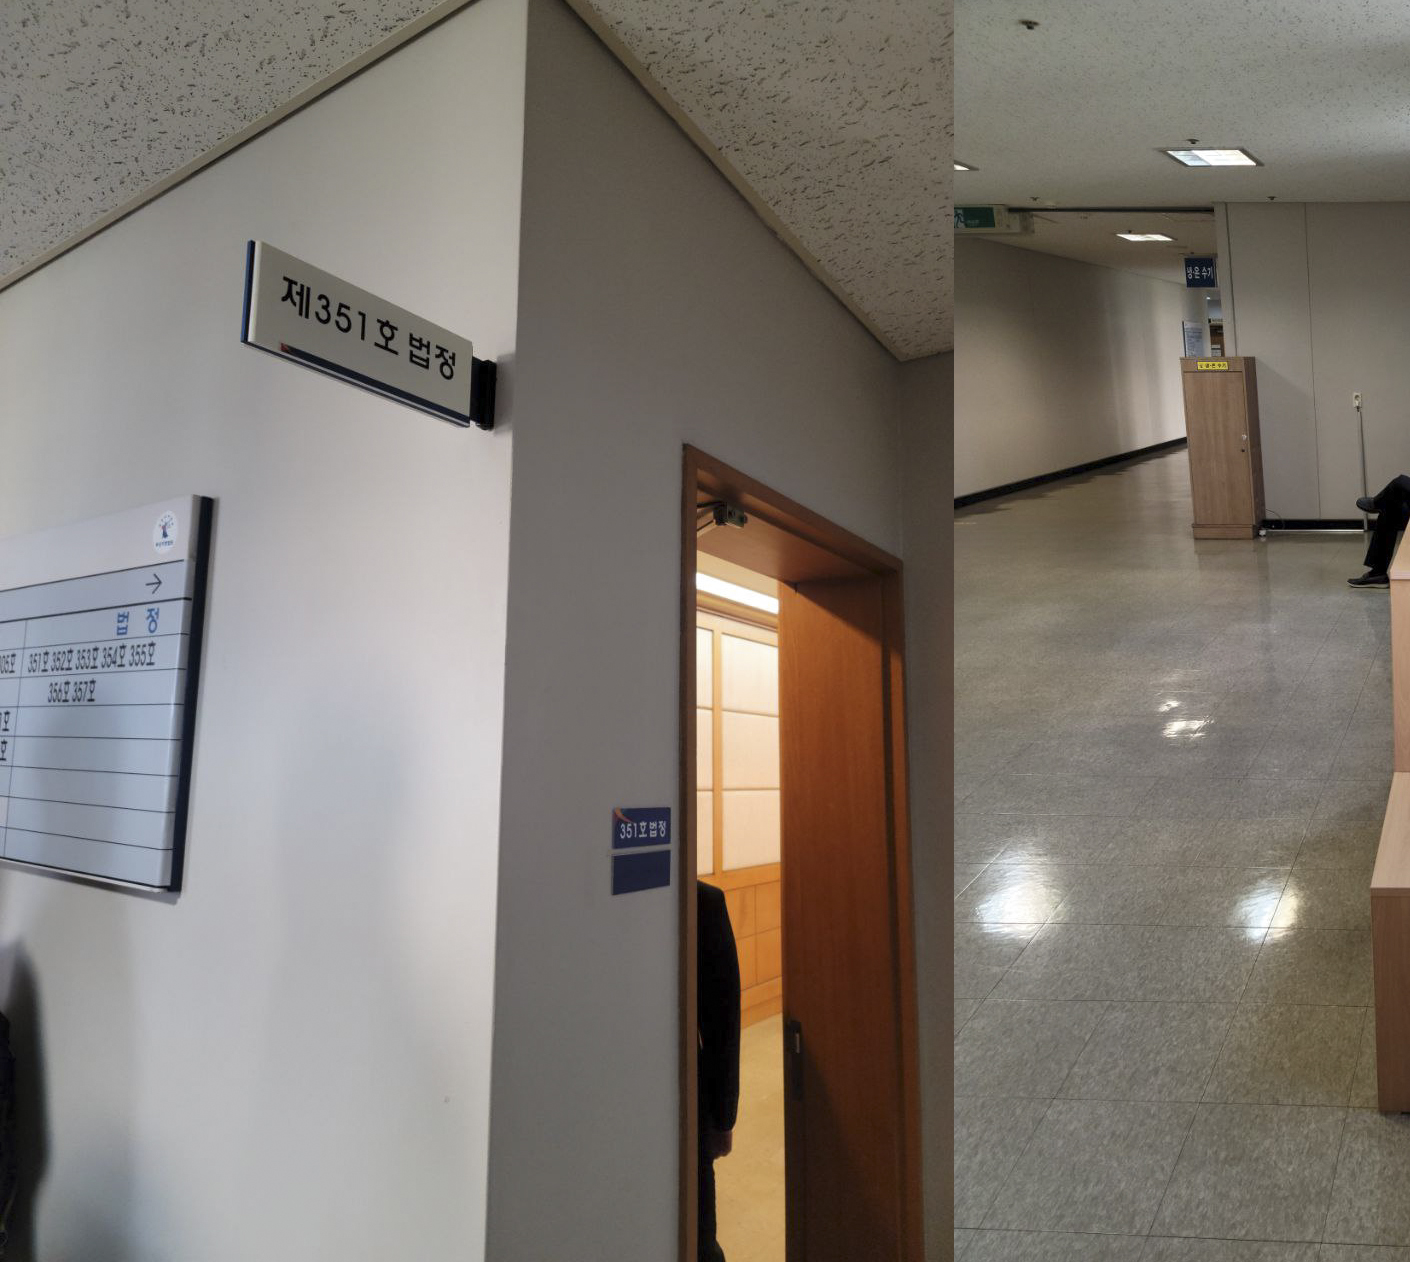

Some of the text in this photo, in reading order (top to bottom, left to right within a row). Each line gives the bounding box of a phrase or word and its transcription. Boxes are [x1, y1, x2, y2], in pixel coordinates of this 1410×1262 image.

[281, 276, 456, 381] 제351호 법정
[28, 640, 156, 673] 351호 352호 353호 354호 355호
[48, 678, 97, 703] 356호 357호
